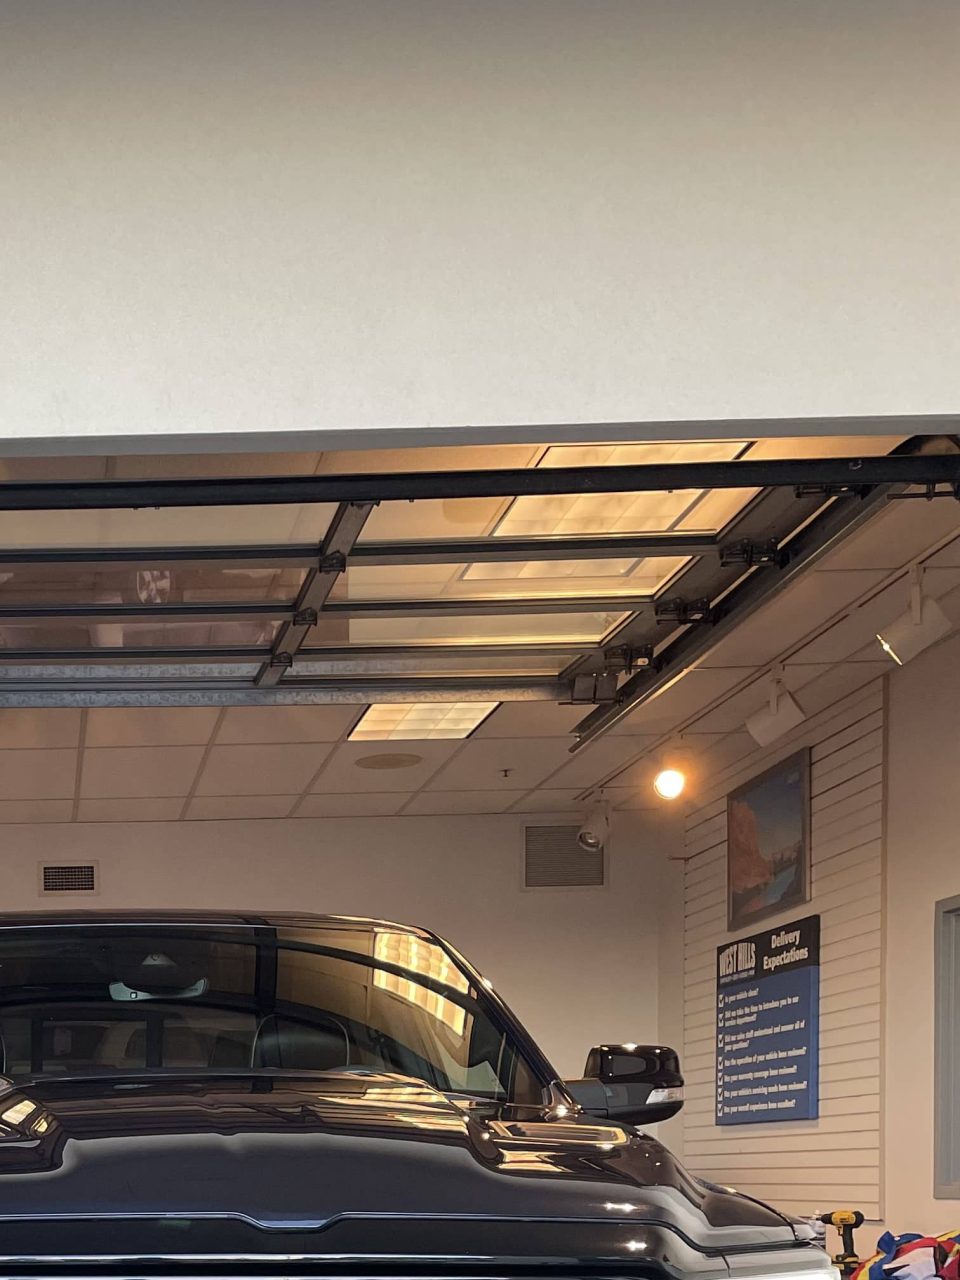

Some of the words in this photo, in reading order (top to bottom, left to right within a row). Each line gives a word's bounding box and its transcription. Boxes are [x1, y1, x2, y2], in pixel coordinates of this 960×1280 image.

[771, 930, 801, 949] Delivery
[719, 945, 737, 977] WEST
[737, 942, 756, 972] HILLS
[763, 947, 809, 971] Expectations
